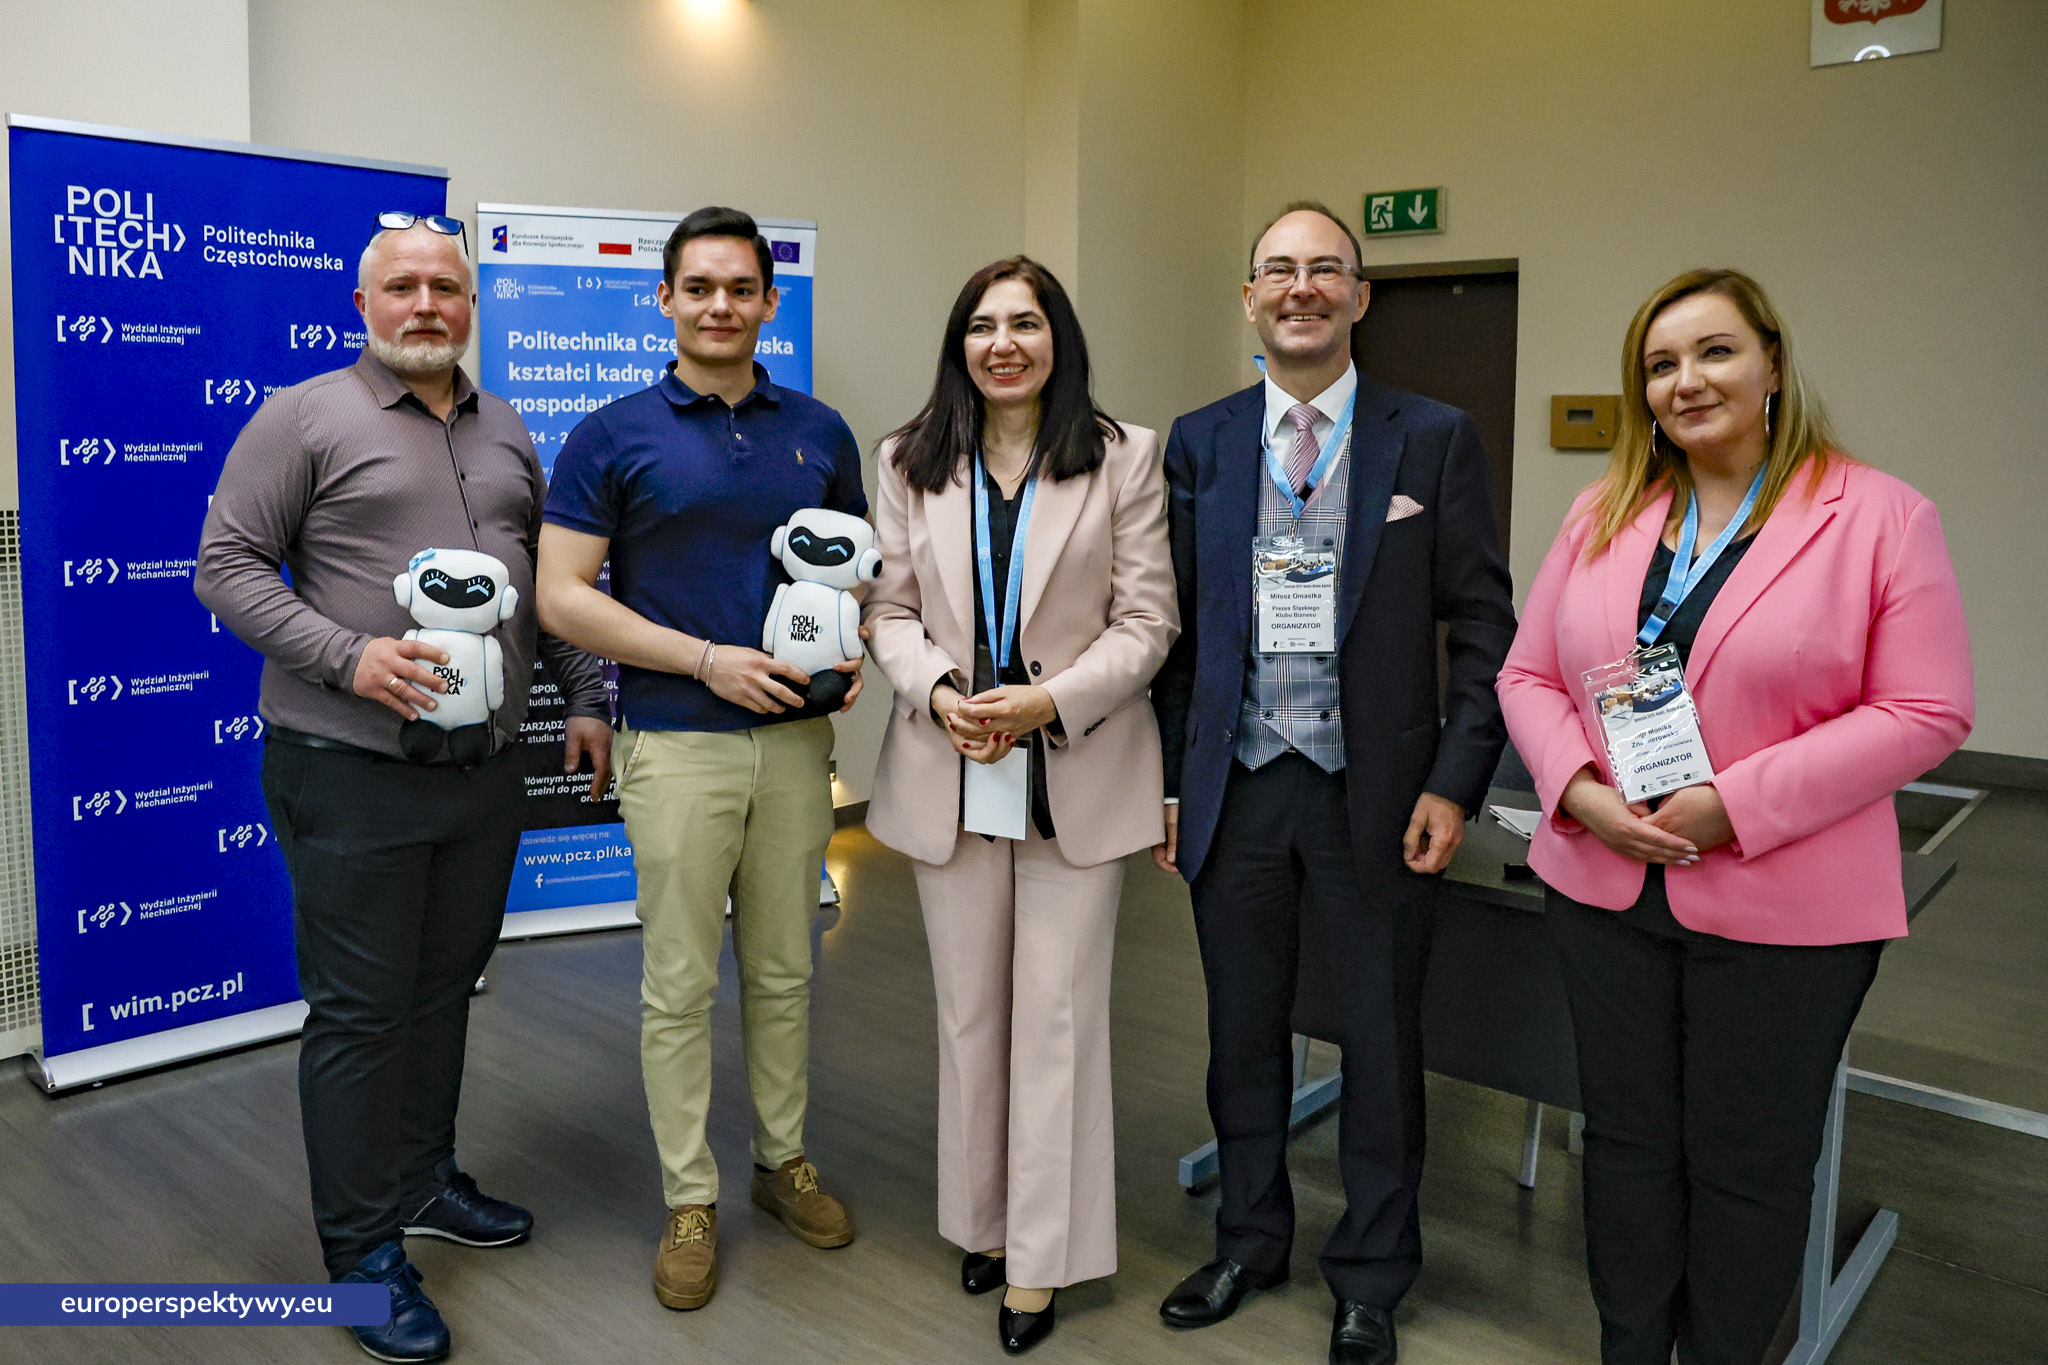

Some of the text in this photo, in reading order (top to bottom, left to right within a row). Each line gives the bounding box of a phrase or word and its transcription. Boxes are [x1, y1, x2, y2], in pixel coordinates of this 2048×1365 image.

[67, 185, 153, 220] POLI
[203, 225, 315, 250] Politechnika
[68, 246, 164, 280] NIKA
[203, 246, 344, 271] Częstochowska
[122, 334, 184, 346] Mechanicznej
[508, 331, 636, 351] Politechnika
[508, 362, 590, 382] kształci
[596, 364, 654, 386] kadrę
[124, 452, 186, 462] Mechanicznej
[128, 568, 190, 580] Mechanicznej
[792, 614, 814, 625] POLI
[792, 622, 818, 634] TECH
[790, 632, 816, 642] NIKA
[433, 666, 460, 678] POLI
[131, 681, 193, 696] Mechanicznej
[557, 785, 570, 794] do
[135, 792, 197, 809] Mechanicznej
[524, 846, 632, 866] www.pcz.pl/ka
[140, 902, 202, 920] Mechanicznej
[110, 972, 244, 1020] wim.pcz.pl
